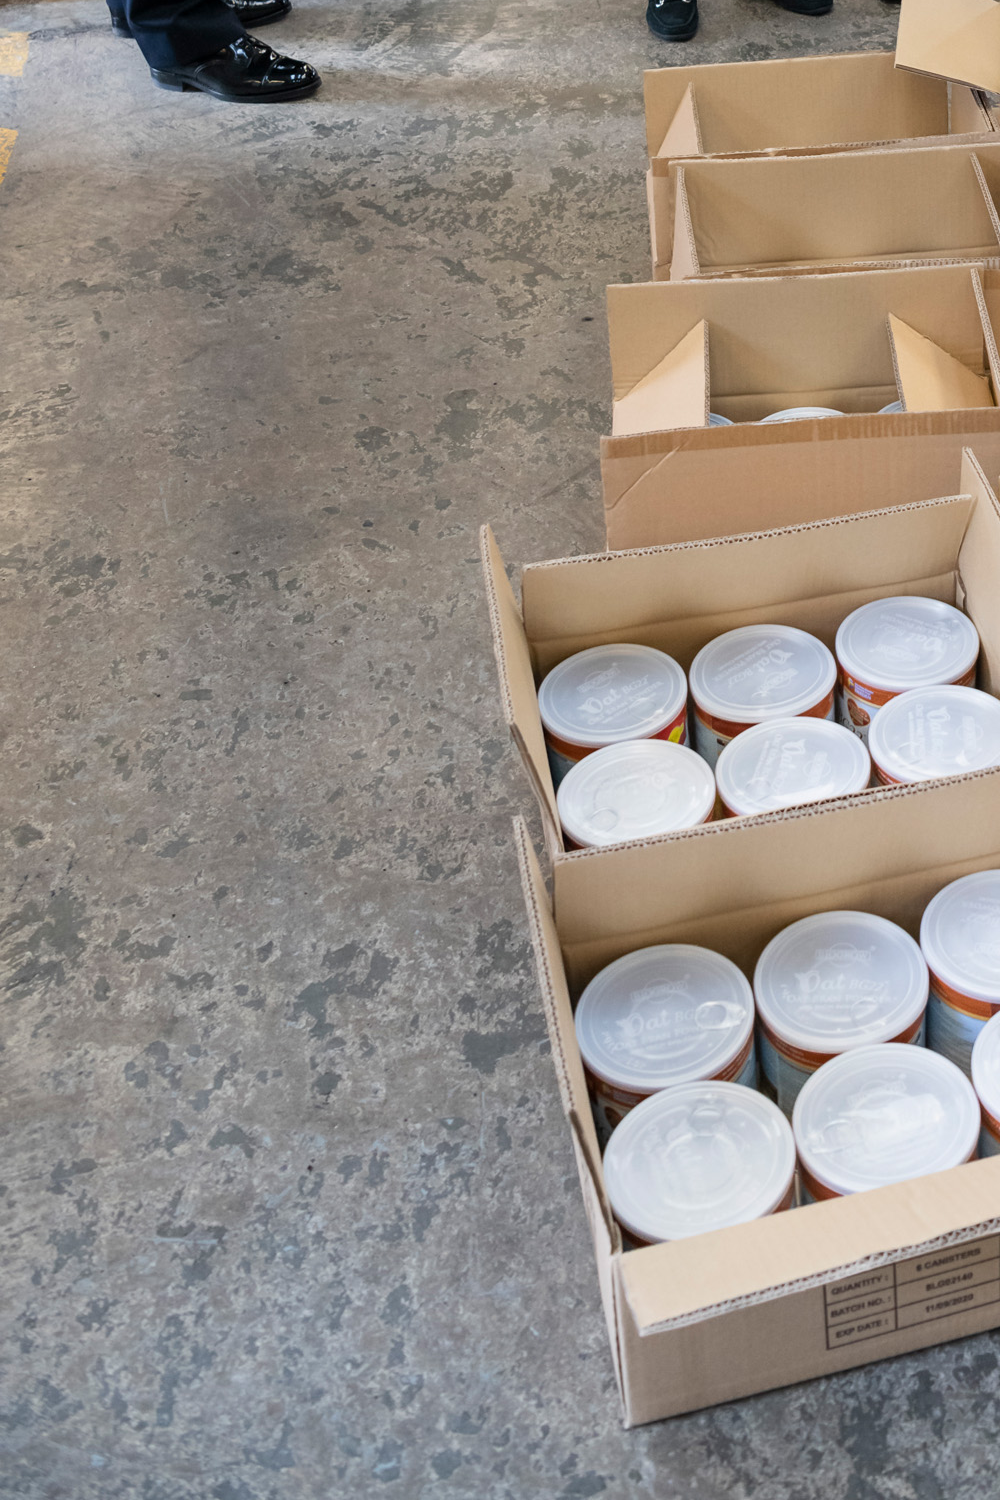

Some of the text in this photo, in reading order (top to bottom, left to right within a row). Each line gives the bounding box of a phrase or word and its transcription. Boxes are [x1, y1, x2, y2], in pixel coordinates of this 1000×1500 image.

[915, 1248, 980, 1273] 6 CANISTERS
[831, 1275, 882, 1296] QUANTITY
[830, 1302, 865, 1318] BATCH
[867, 1297, 885, 1308] NO.
[835, 1327, 855, 1339] EXP
[857, 1319, 883, 1333] DATE
